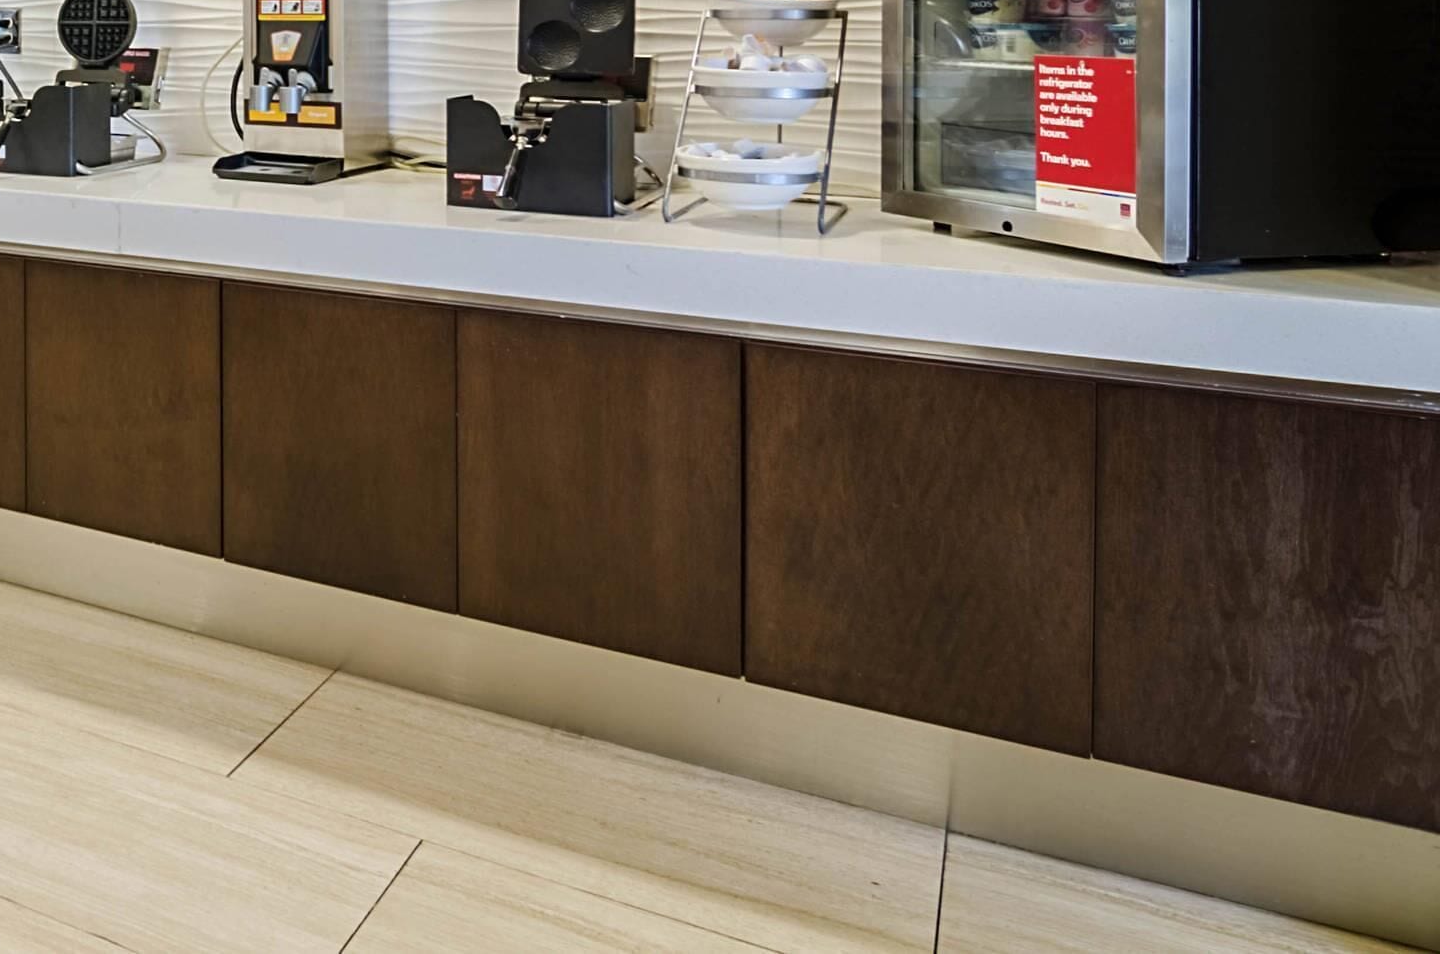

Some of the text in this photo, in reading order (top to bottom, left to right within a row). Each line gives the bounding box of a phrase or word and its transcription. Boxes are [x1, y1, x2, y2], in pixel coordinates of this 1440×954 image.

[1039, 63, 1095, 77] Items in the
[1039, 77, 1094, 90] refrigerator
[1039, 91, 1098, 103] are available
[1039, 102, 1093, 118] only during
[1039, 114, 1085, 128] breakfast
[1040, 126, 1070, 139] hours.
[1040, 151, 1092, 168] Thank you.
